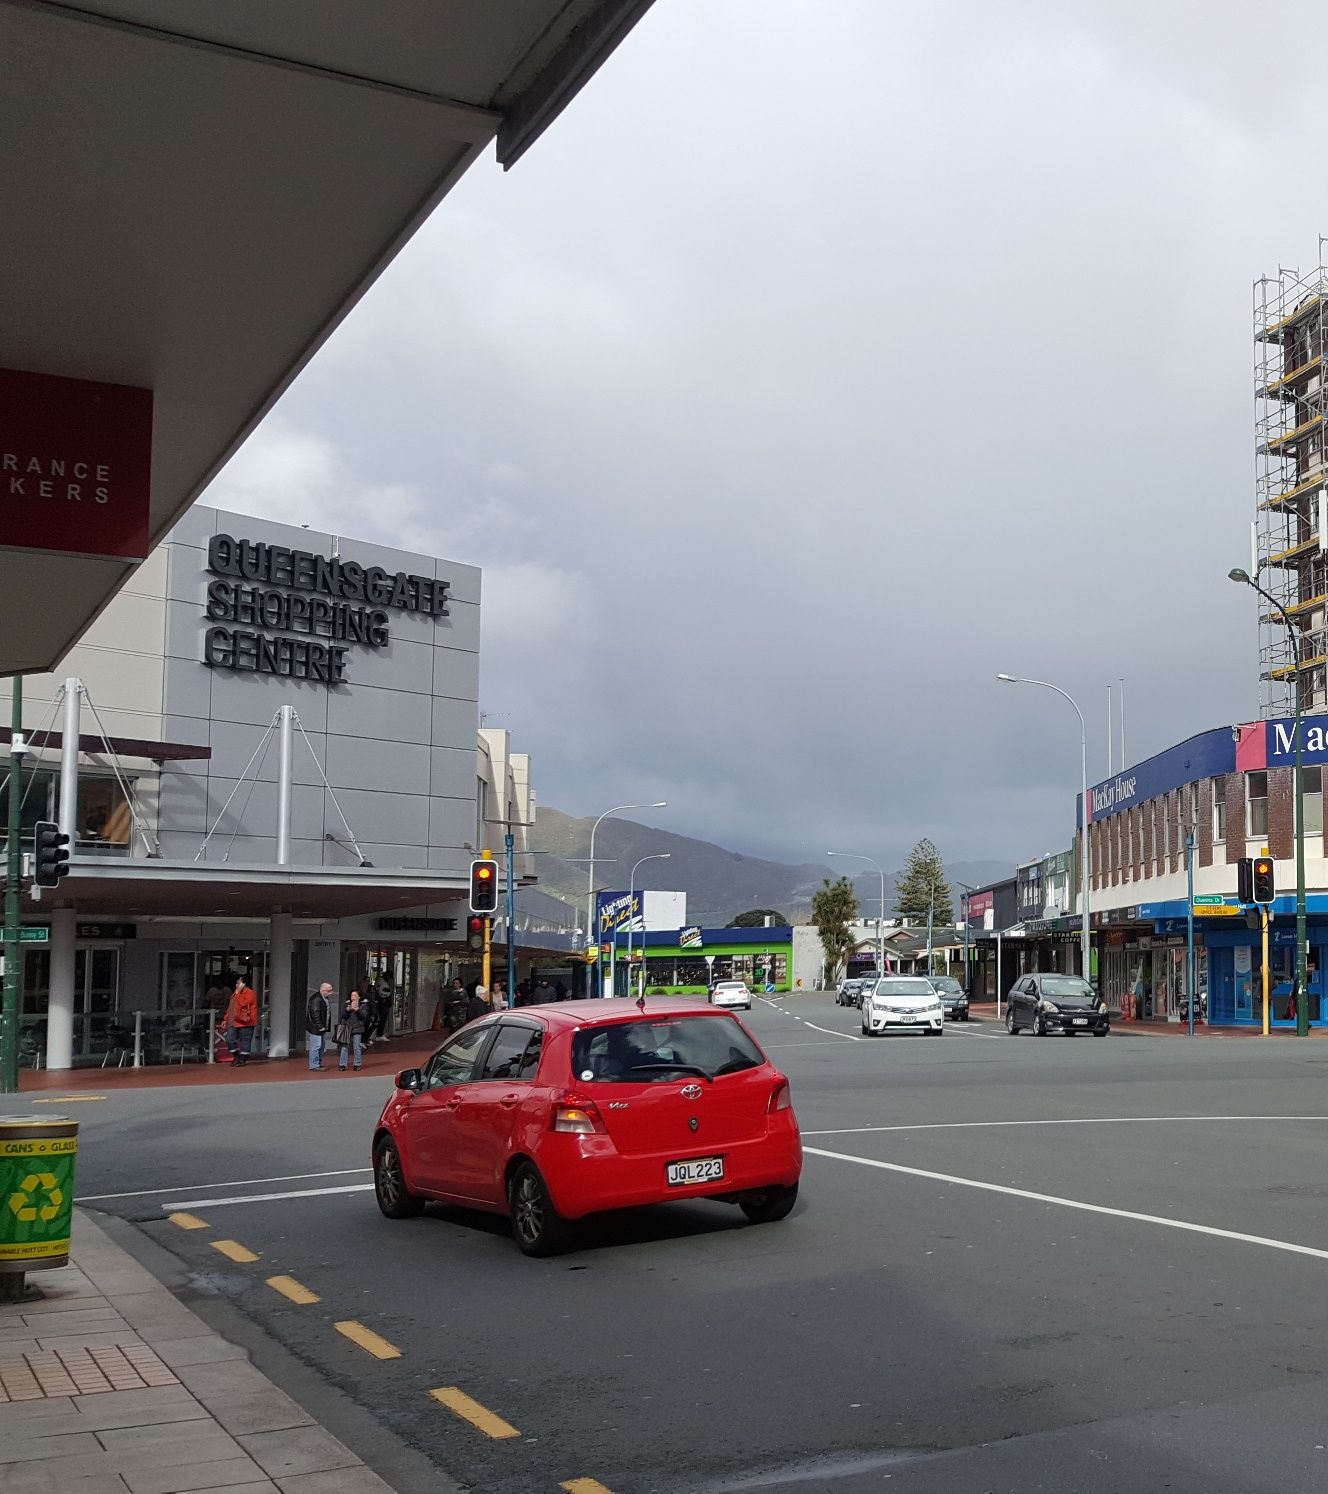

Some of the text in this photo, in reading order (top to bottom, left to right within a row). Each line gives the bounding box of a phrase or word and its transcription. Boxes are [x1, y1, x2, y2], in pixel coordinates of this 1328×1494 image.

[207, 533, 451, 616] QUEENSGATE
[206, 580, 389, 647] SHOPPING
[204, 626, 350, 683] CENTRE
[1092, 777, 1136, 812] MacKay House
[601, 894, 632, 916] Lighting
[5, 1142, 74, 1153] CANS GLASS
[670, 1161, 722, 1181] JQL223
